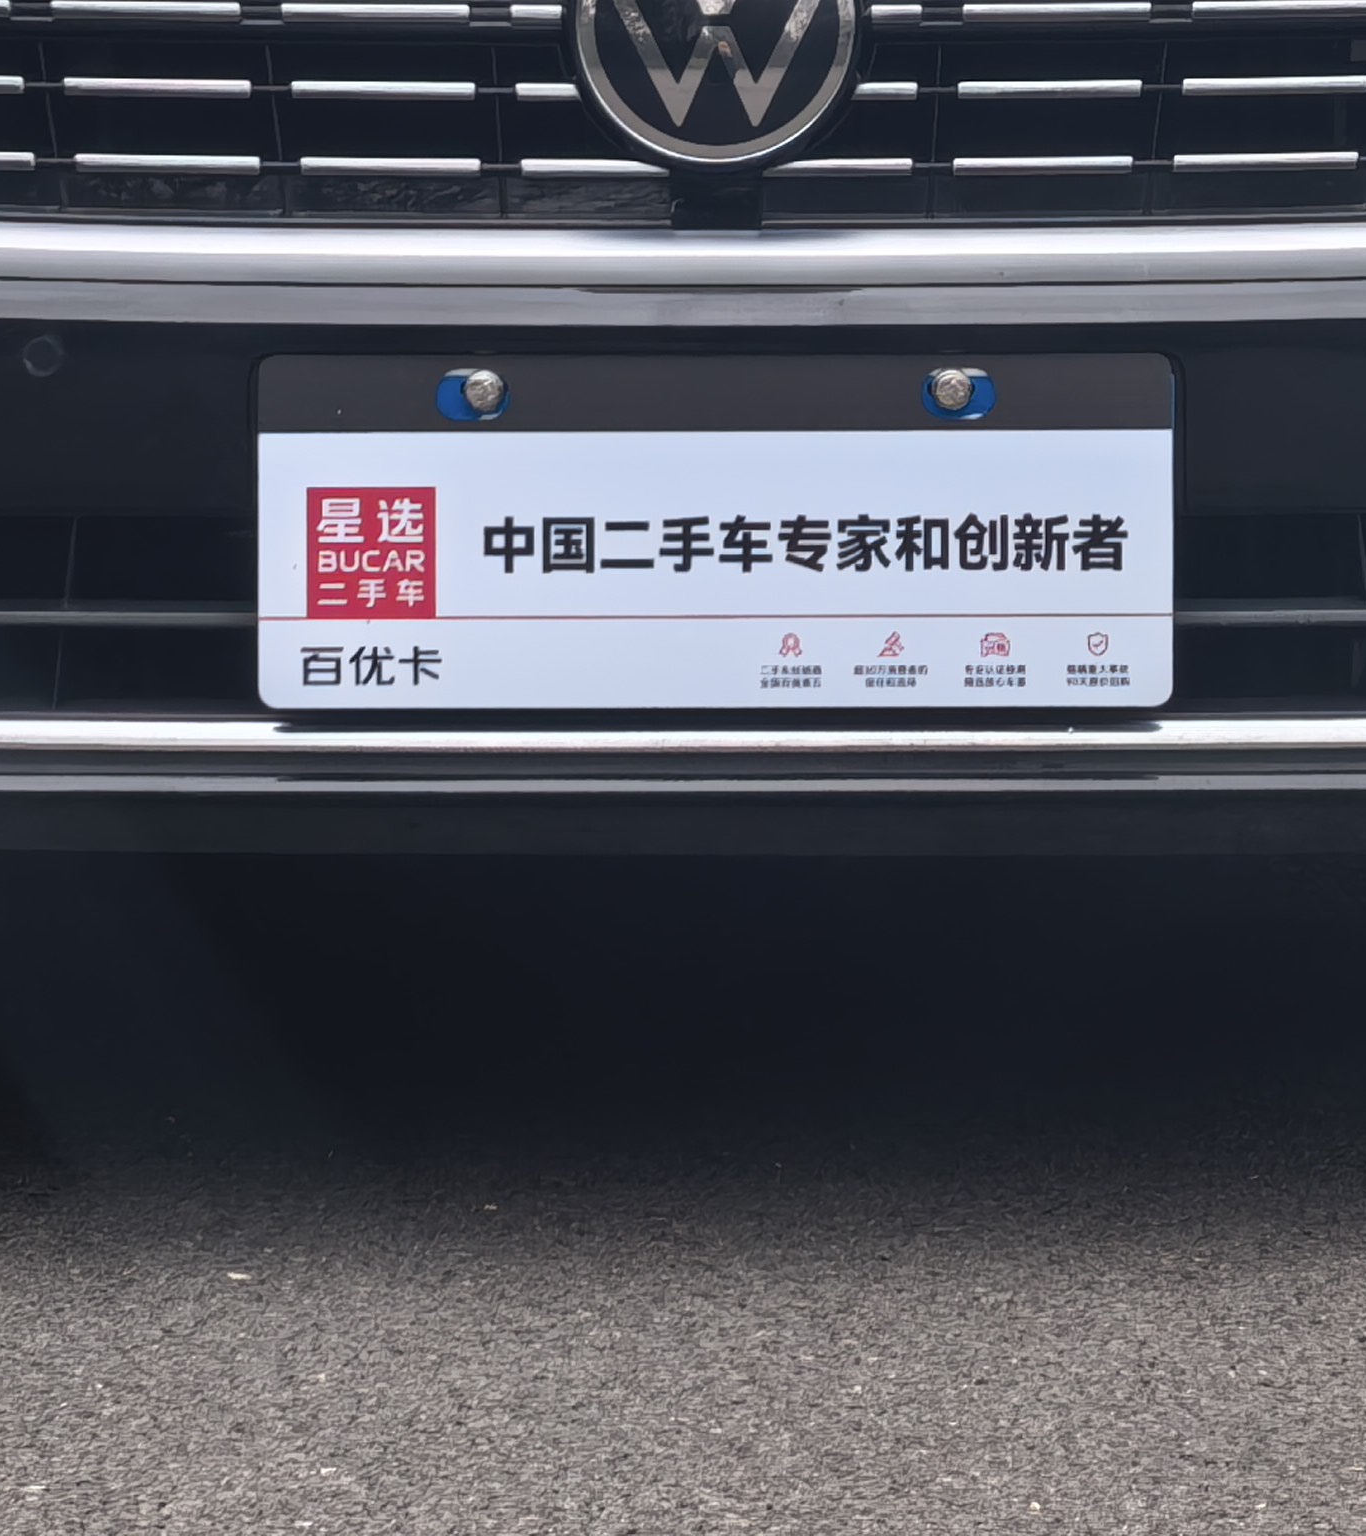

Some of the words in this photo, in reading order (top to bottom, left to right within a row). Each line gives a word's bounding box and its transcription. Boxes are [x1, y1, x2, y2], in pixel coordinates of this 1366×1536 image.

[316, 497, 425, 543] 星选
[317, 549, 425, 574] BUCAR
[483, 512, 1129, 574] 中国二手车专家和创新者
[317, 579, 425, 608] 二手车
[300, 645, 442, 686] 百优卡
